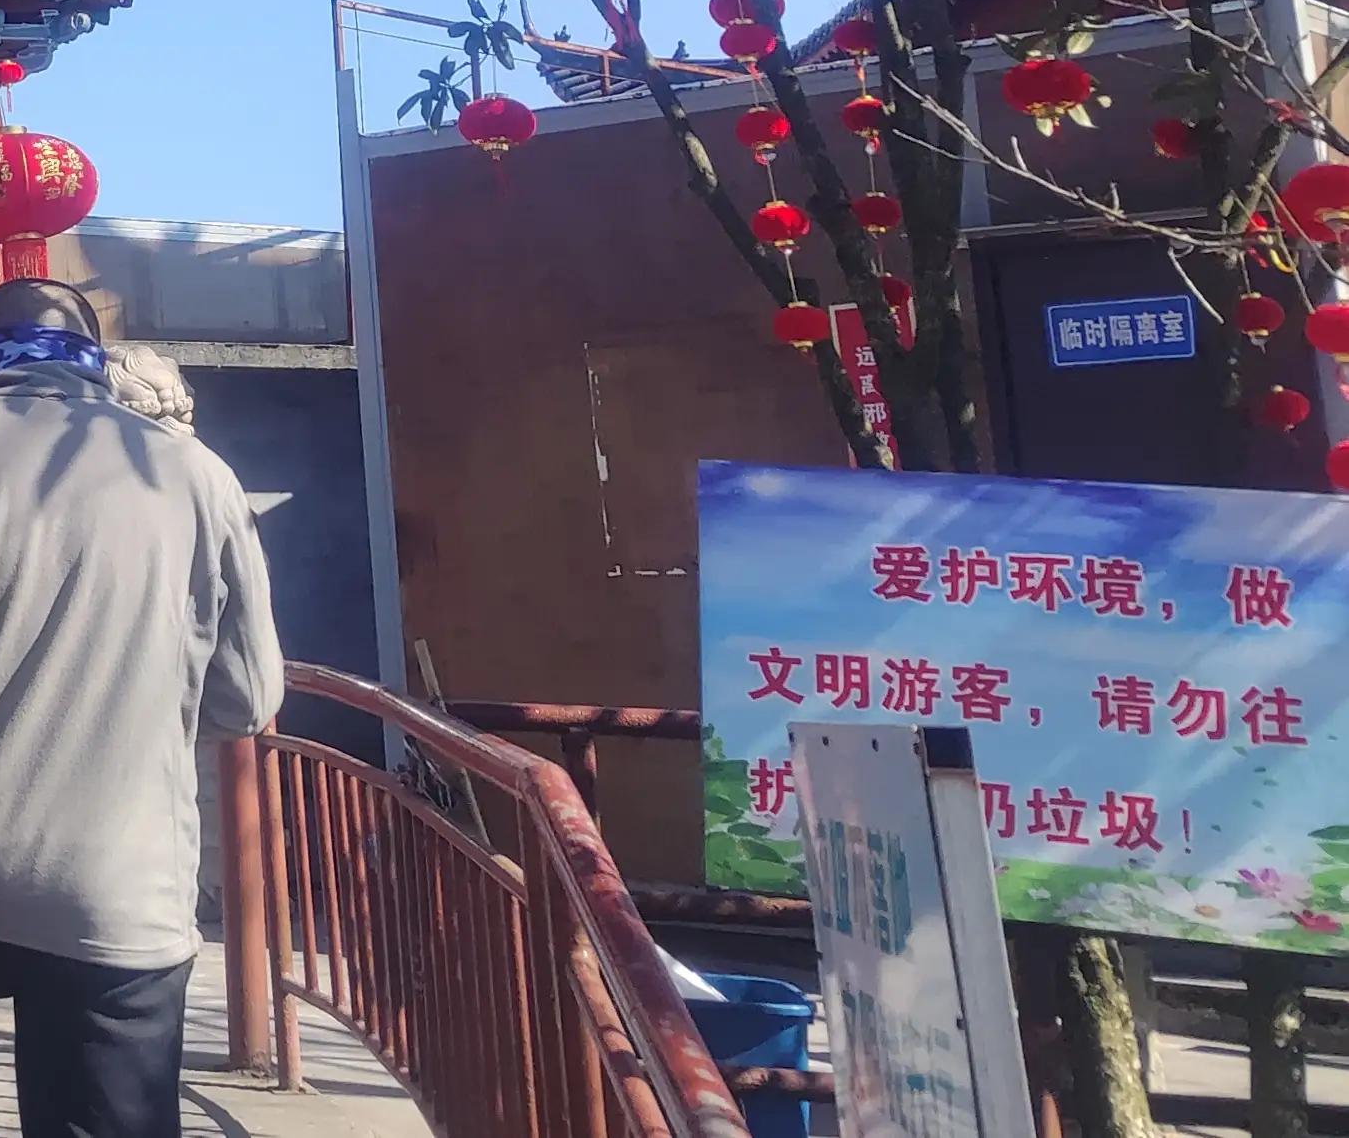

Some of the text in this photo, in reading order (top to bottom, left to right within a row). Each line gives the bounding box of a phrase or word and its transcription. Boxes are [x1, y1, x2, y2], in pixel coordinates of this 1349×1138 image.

[1059, 310, 1185, 351] 临时隔离室
[872, 544, 1294, 629] 爱护环境，做
[747, 647, 1308, 747] 文明游客，请勿往
[750, 757, 1194, 855] 护扔垃圾！
